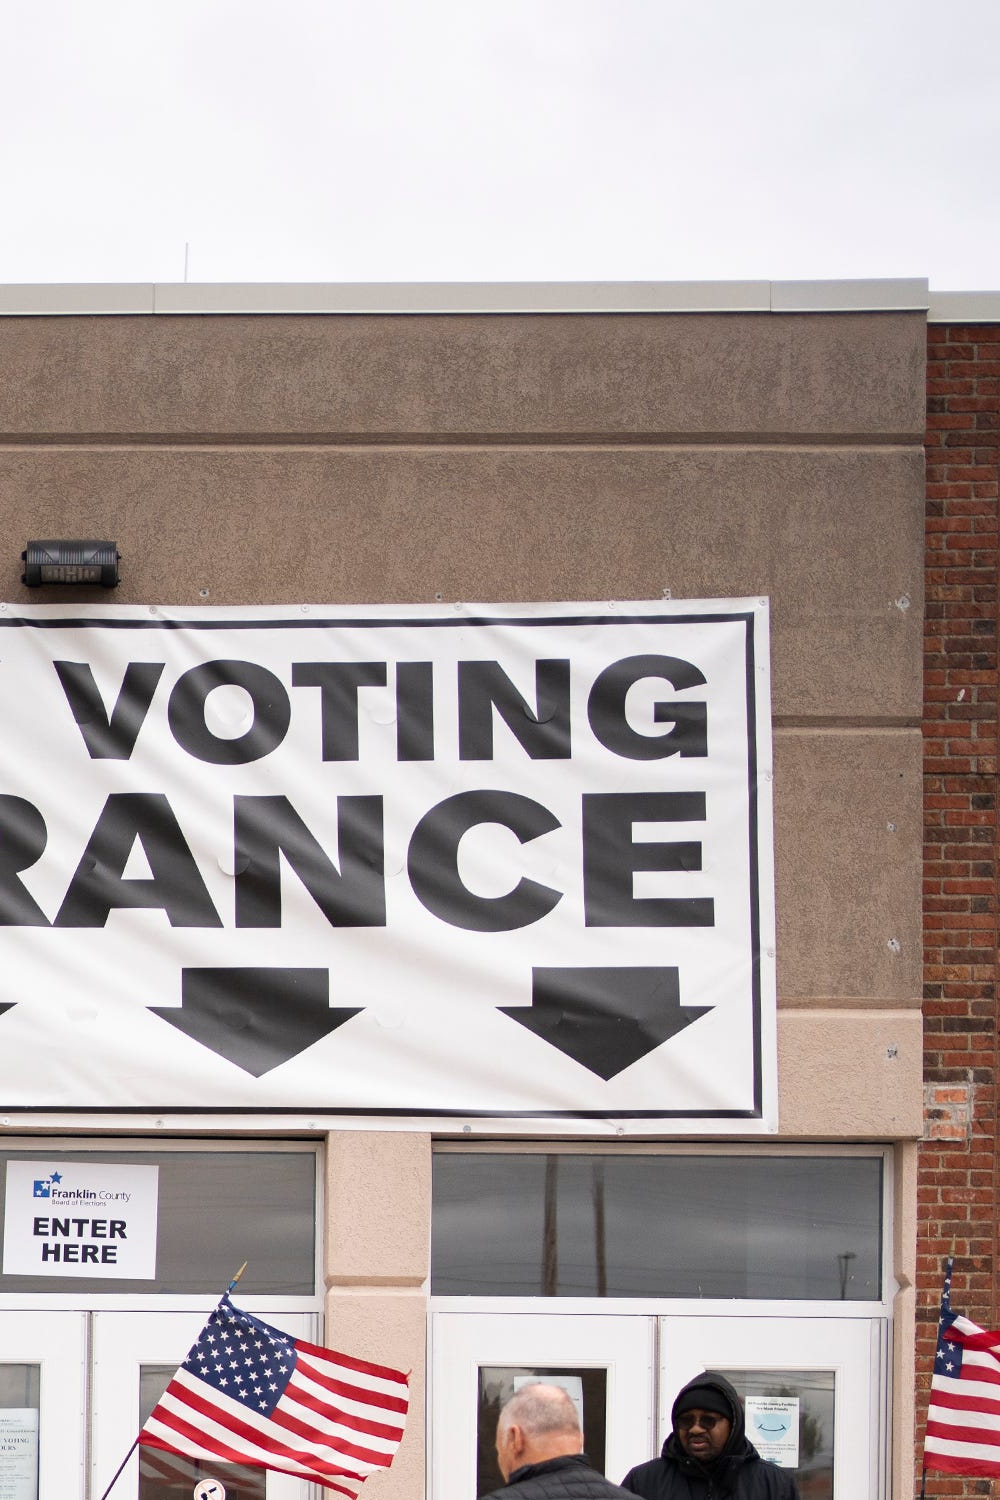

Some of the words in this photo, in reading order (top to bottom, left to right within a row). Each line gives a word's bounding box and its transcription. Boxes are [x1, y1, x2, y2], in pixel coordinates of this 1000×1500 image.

[52, 654, 709, 765] VOTING
[51, 1189, 97, 1200] Franklin
[98, 1190, 132, 1203] County
[33, 1217, 127, 1239] ENTER
[41, 1243, 118, 1264] HERE
